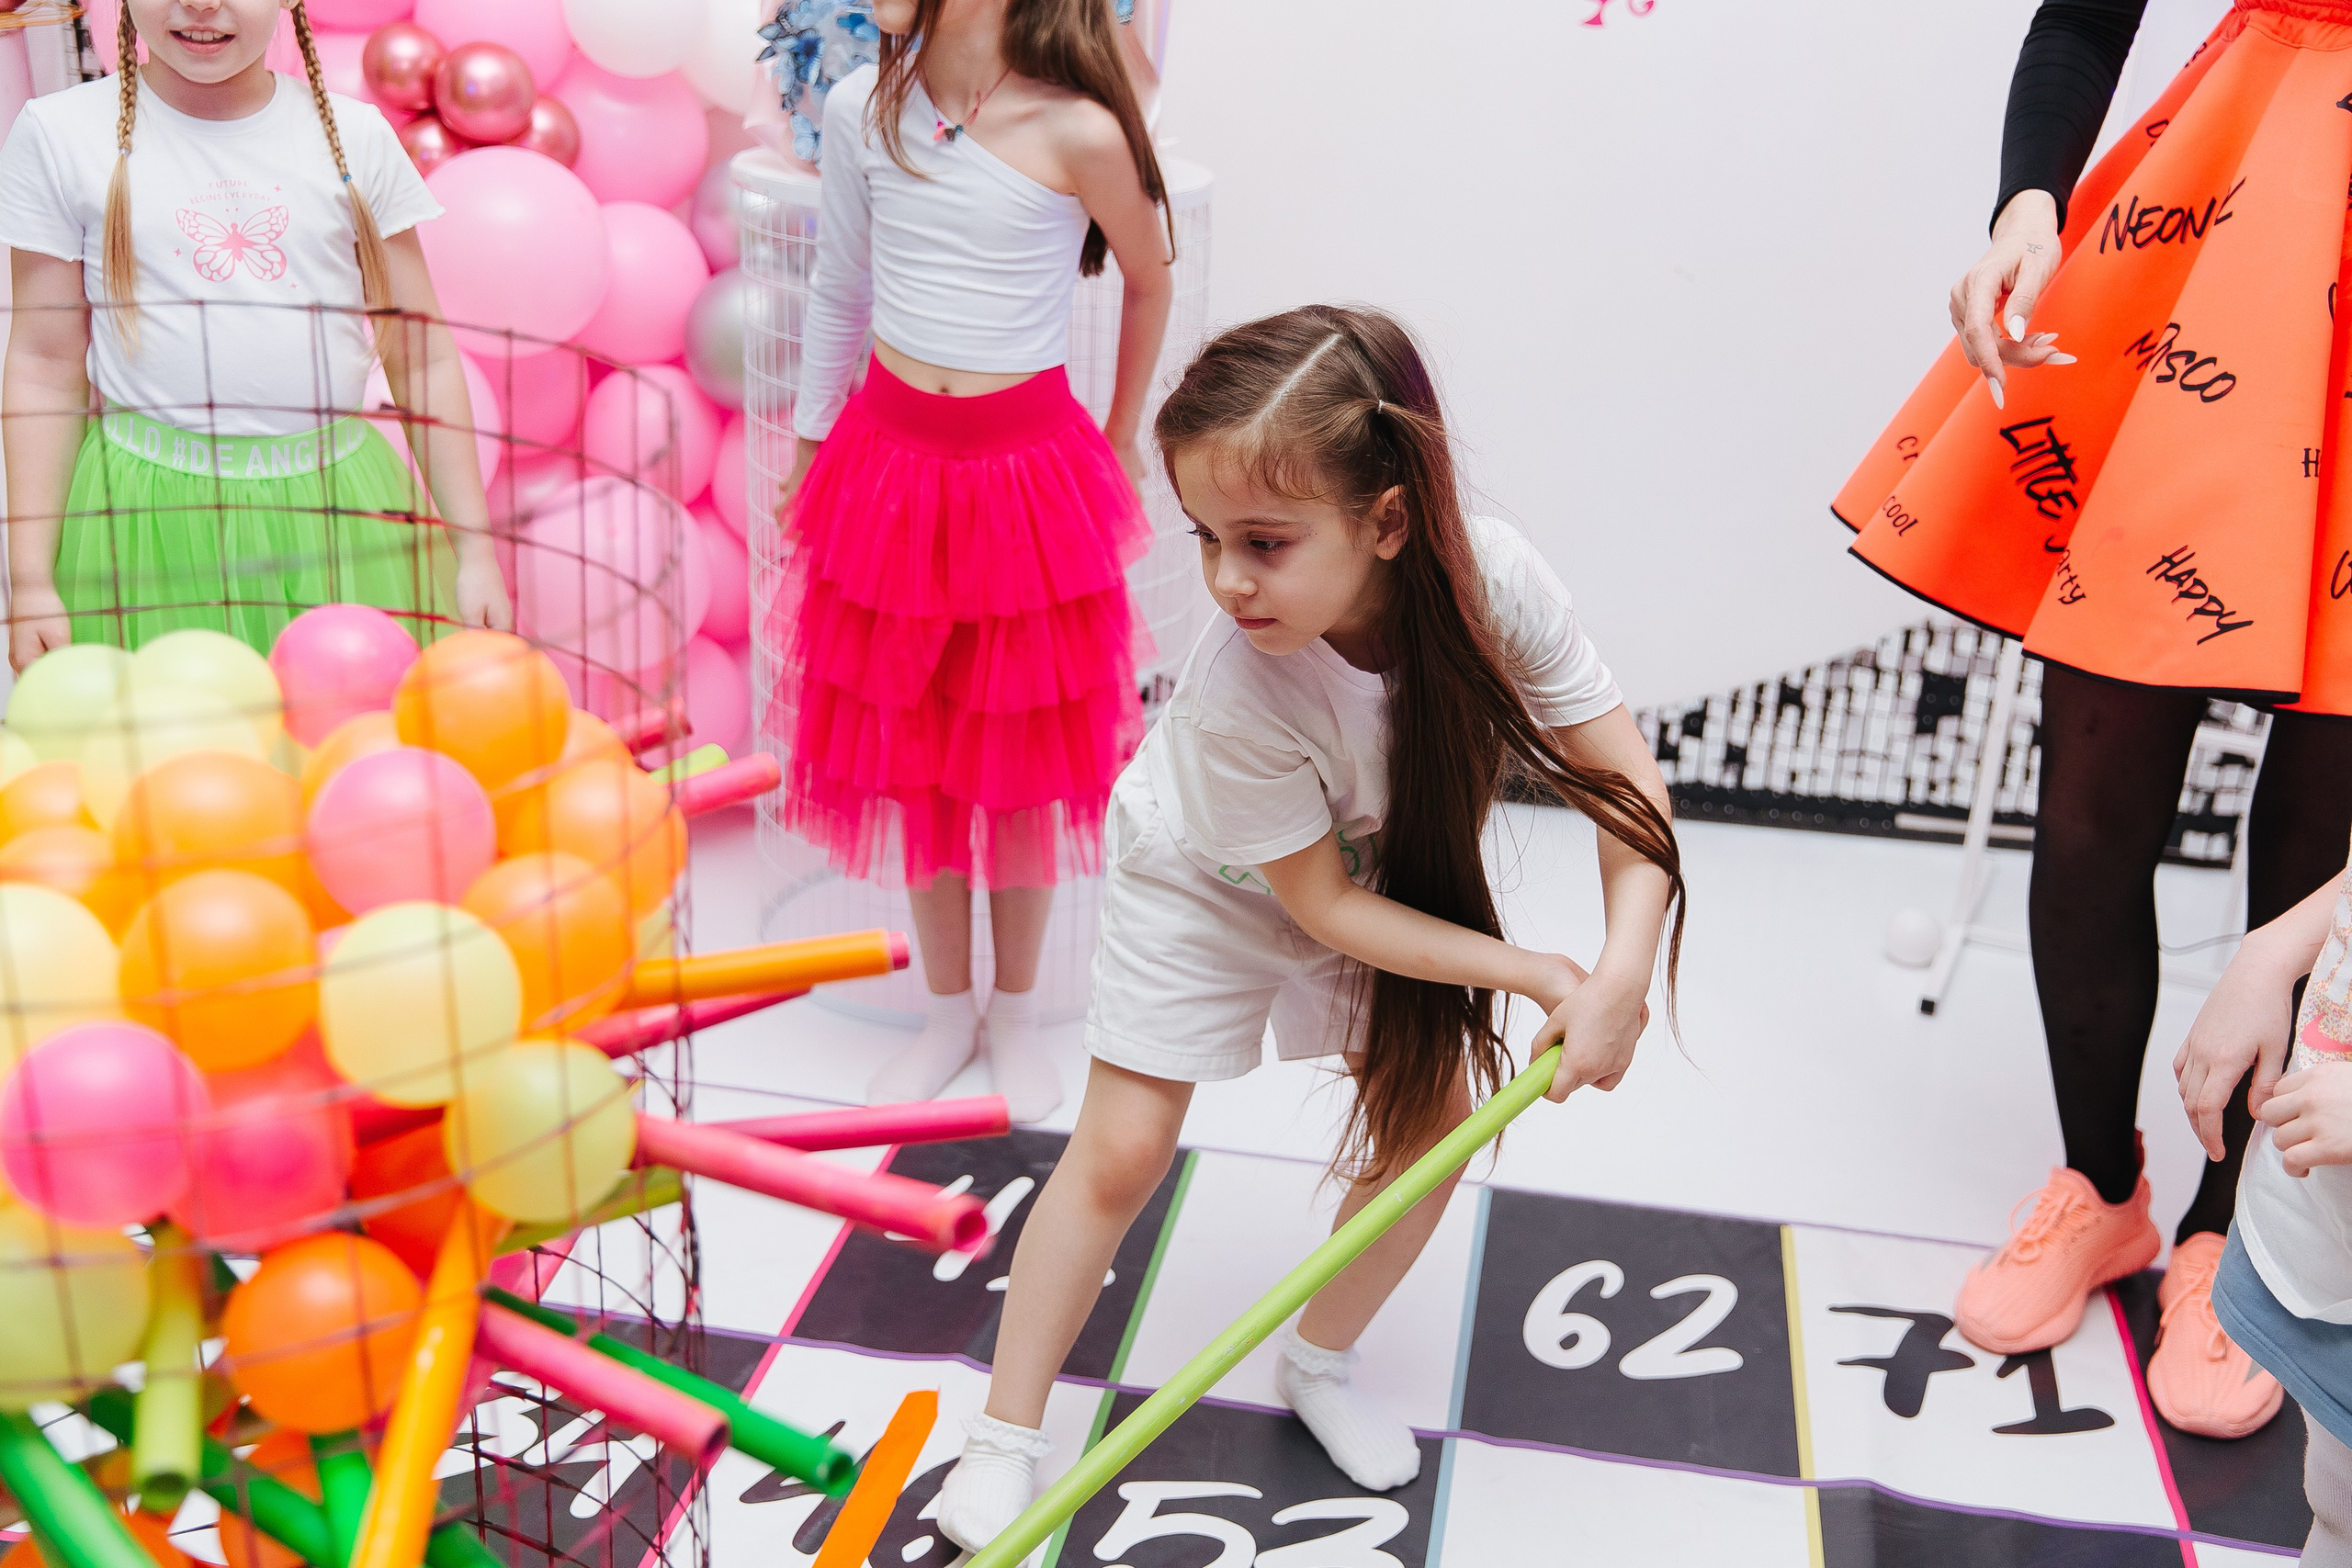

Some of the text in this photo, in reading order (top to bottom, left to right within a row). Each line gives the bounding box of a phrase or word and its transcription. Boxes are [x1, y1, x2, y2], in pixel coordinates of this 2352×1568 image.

[172, 435, 234, 477] #DE
[2145, 544, 2254, 646] HAPPY
[1523, 1259, 1744, 1380] 62
[1828, 1304, 2116, 1435] 71
